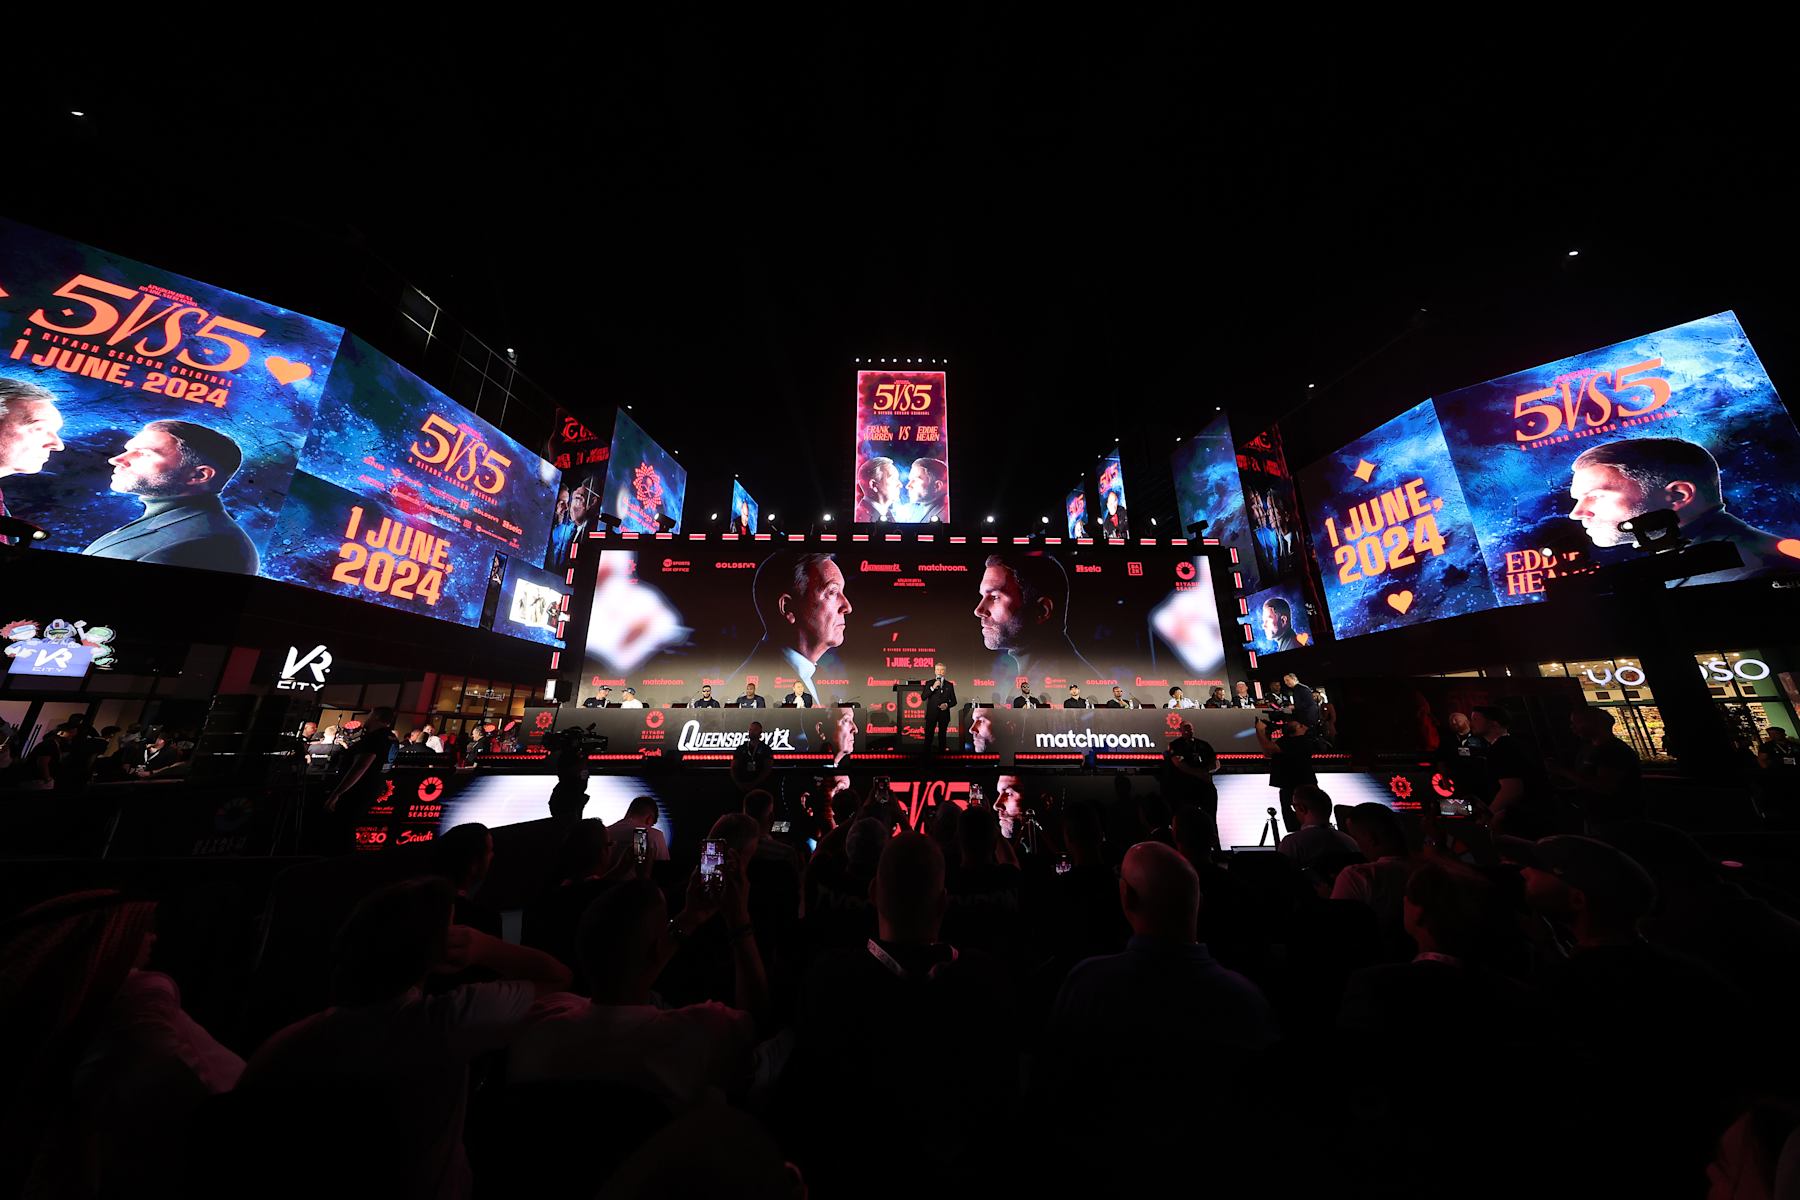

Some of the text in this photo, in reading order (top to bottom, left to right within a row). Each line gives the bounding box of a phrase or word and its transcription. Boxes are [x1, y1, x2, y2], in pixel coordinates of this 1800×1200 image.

[23, 327, 233, 388] A RIYADH SEASON ORIGINAL
[10, 338, 230, 409] 1 JUNE, 2024
[863, 433, 893, 441] WARREN
[866, 425, 890, 433] FRANK
[898, 425, 911, 441] VS
[916, 433, 940, 442] HEARN
[918, 425, 938, 433] EDDIE
[1532, 435, 1570, 449] RIYADH
[1575, 424, 1617, 438] SEASON
[1324, 477, 1444, 548] 1 JUNE,
[344, 505, 454, 574] 1 JUNE,
[1334, 513, 1446, 585] 2024
[331, 542, 444, 606] 2024
[918, 563, 968, 572] matchroom.
[34, 647, 72, 669] VR
[281, 644, 333, 683] VR
[913, 657, 933, 667] 2024
[276, 680, 325, 692] CITY
[1035, 728, 1156, 749] matchroom.
